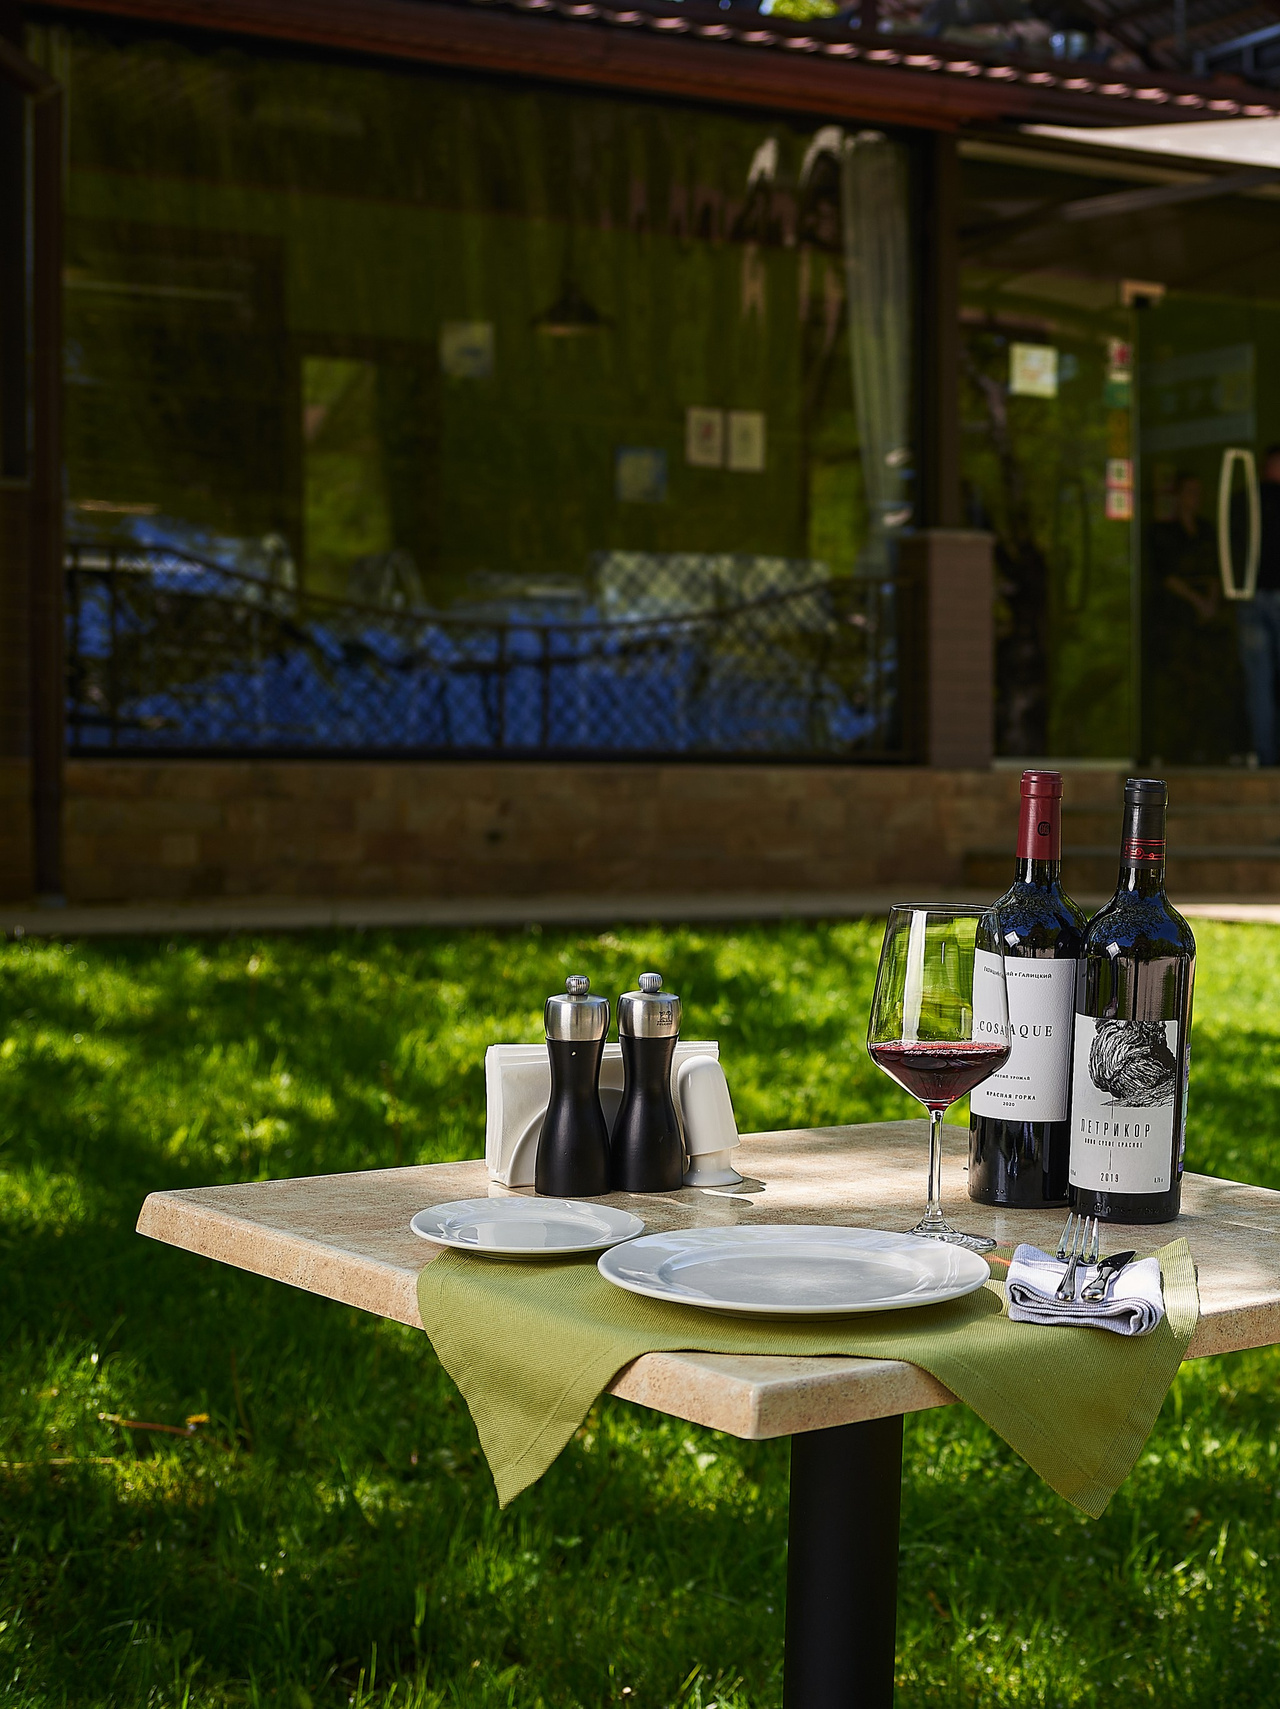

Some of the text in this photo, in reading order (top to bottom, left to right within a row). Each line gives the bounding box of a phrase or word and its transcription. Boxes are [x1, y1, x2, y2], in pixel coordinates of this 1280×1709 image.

[986, 1090, 1012, 1099] КРАСНАЯ
[1081, 1118, 1150, 1138] ПЕТРИКОР
[1100, 1172, 1119, 1183] 2019
